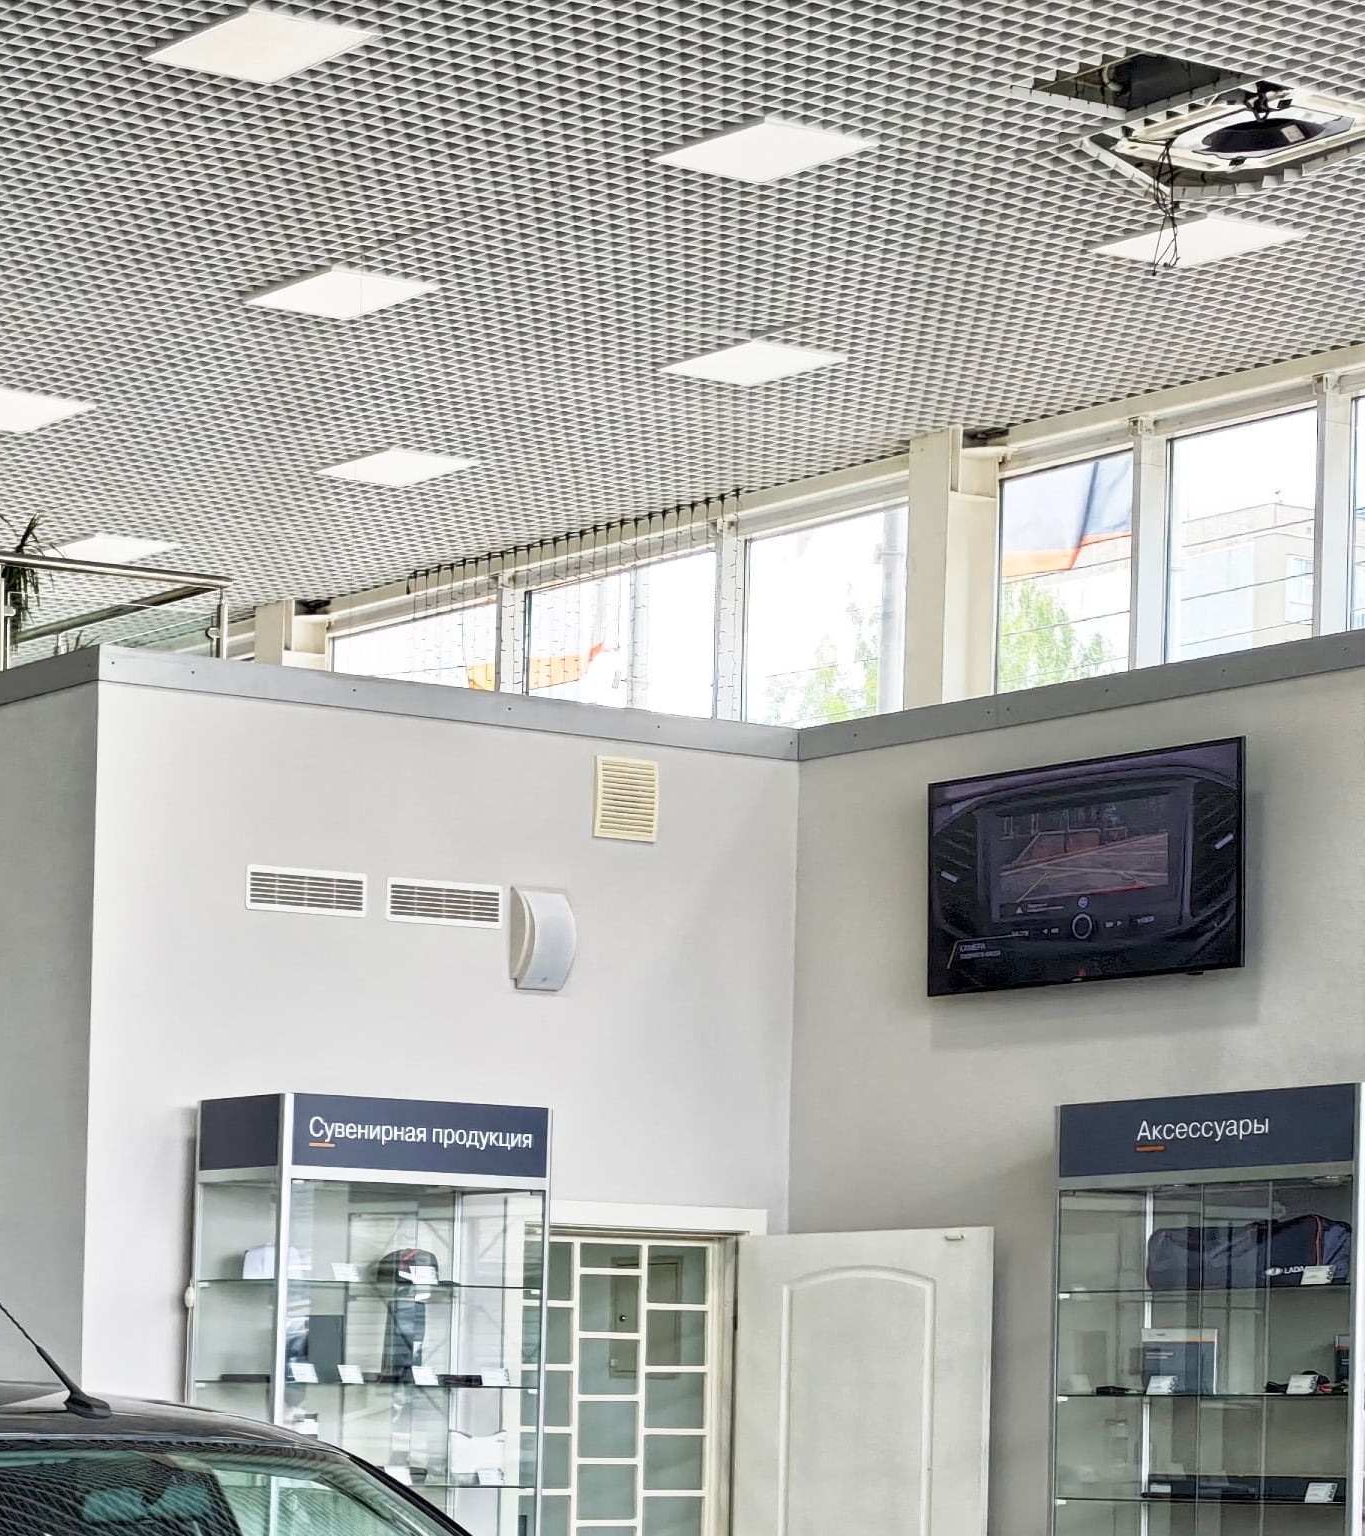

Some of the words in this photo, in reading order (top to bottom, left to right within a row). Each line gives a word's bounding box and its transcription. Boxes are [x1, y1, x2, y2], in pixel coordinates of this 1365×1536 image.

[309, 1116, 427, 1145] Сувенирная
[432, 1128, 533, 1151] продукция
[1136, 1117, 1269, 1142] Аксессуары
